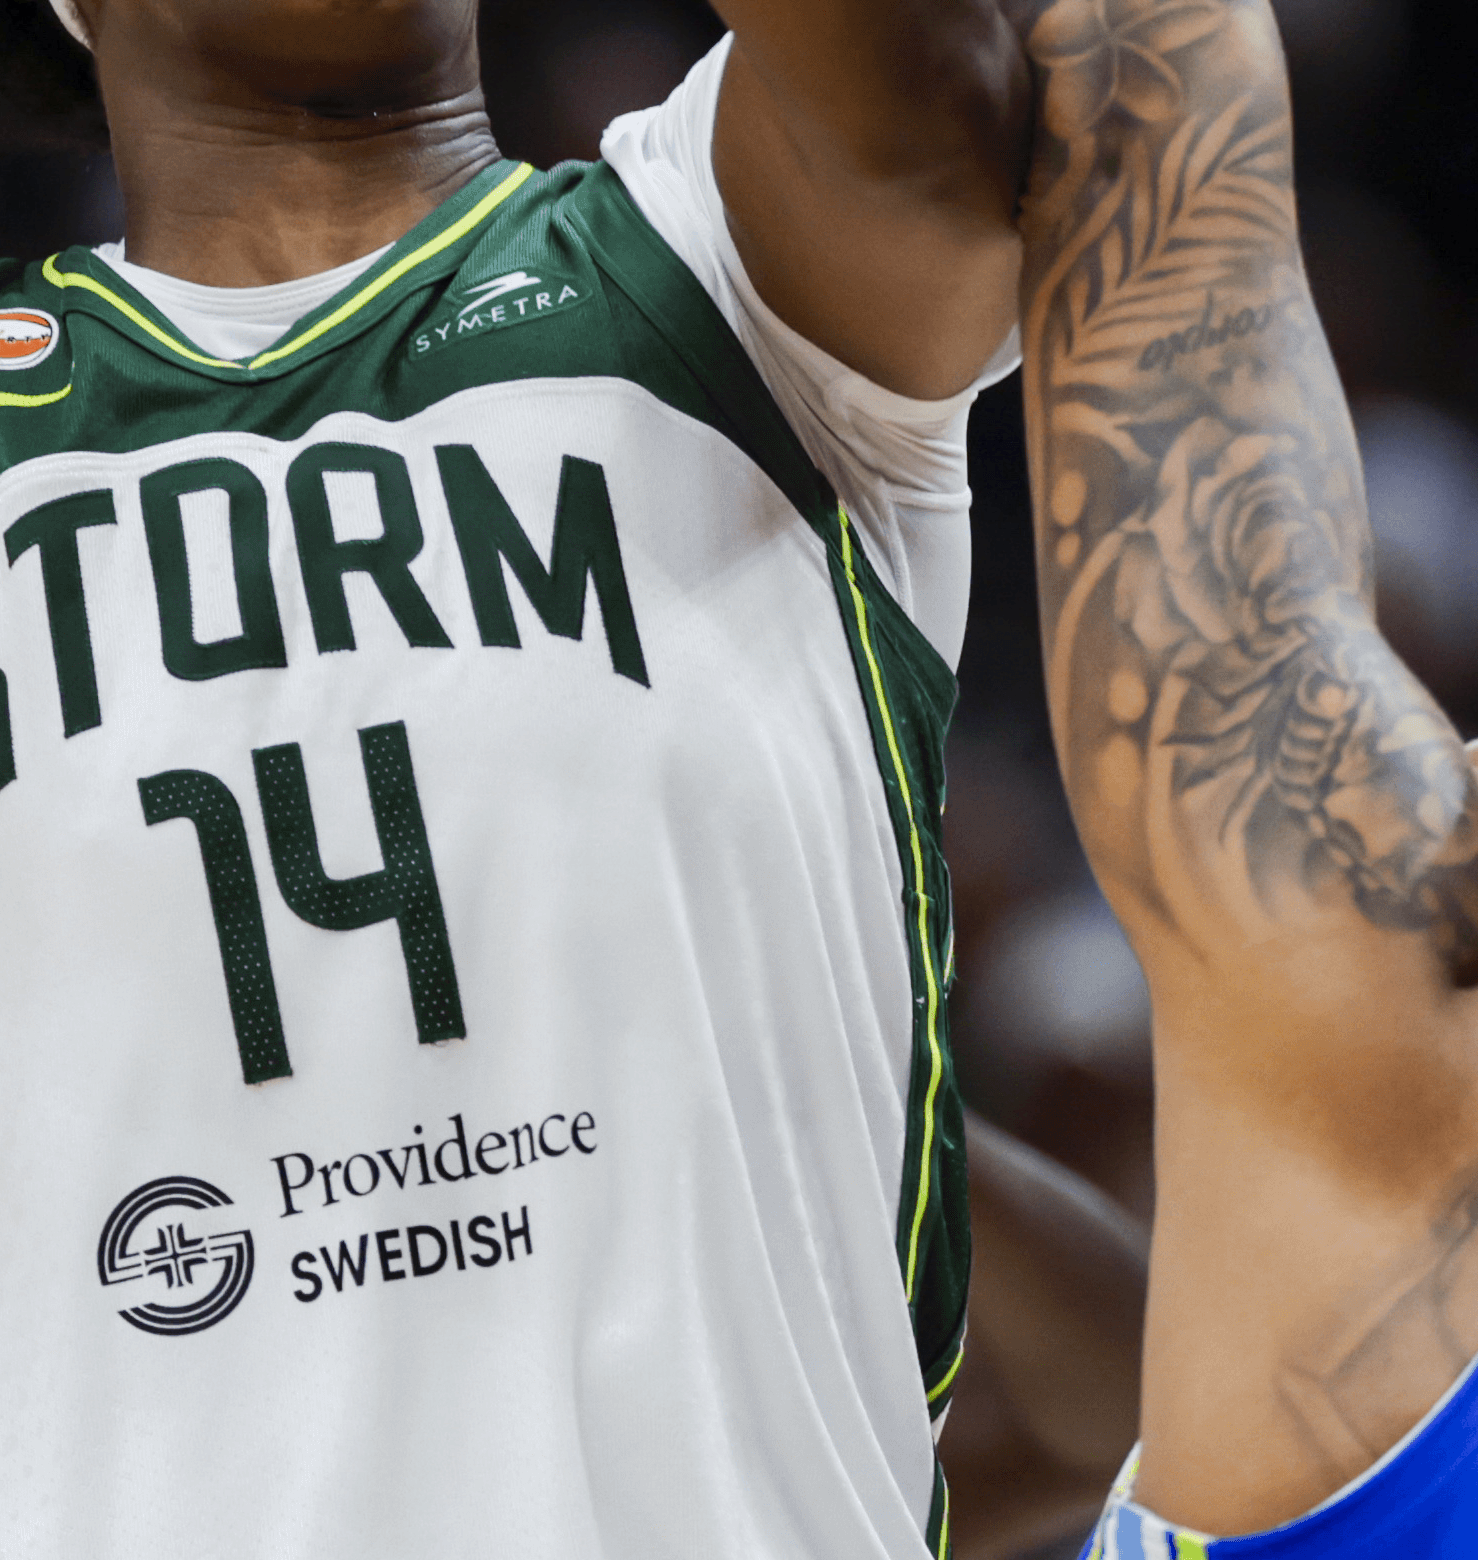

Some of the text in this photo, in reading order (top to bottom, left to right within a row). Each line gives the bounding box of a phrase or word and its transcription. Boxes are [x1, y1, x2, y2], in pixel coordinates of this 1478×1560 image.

[415, 284, 579, 353] SYMETRA
[136, 719, 468, 1087] 14
[269, 1110, 598, 1218] Providence
[290, 1205, 534, 1303] SWEDISH
